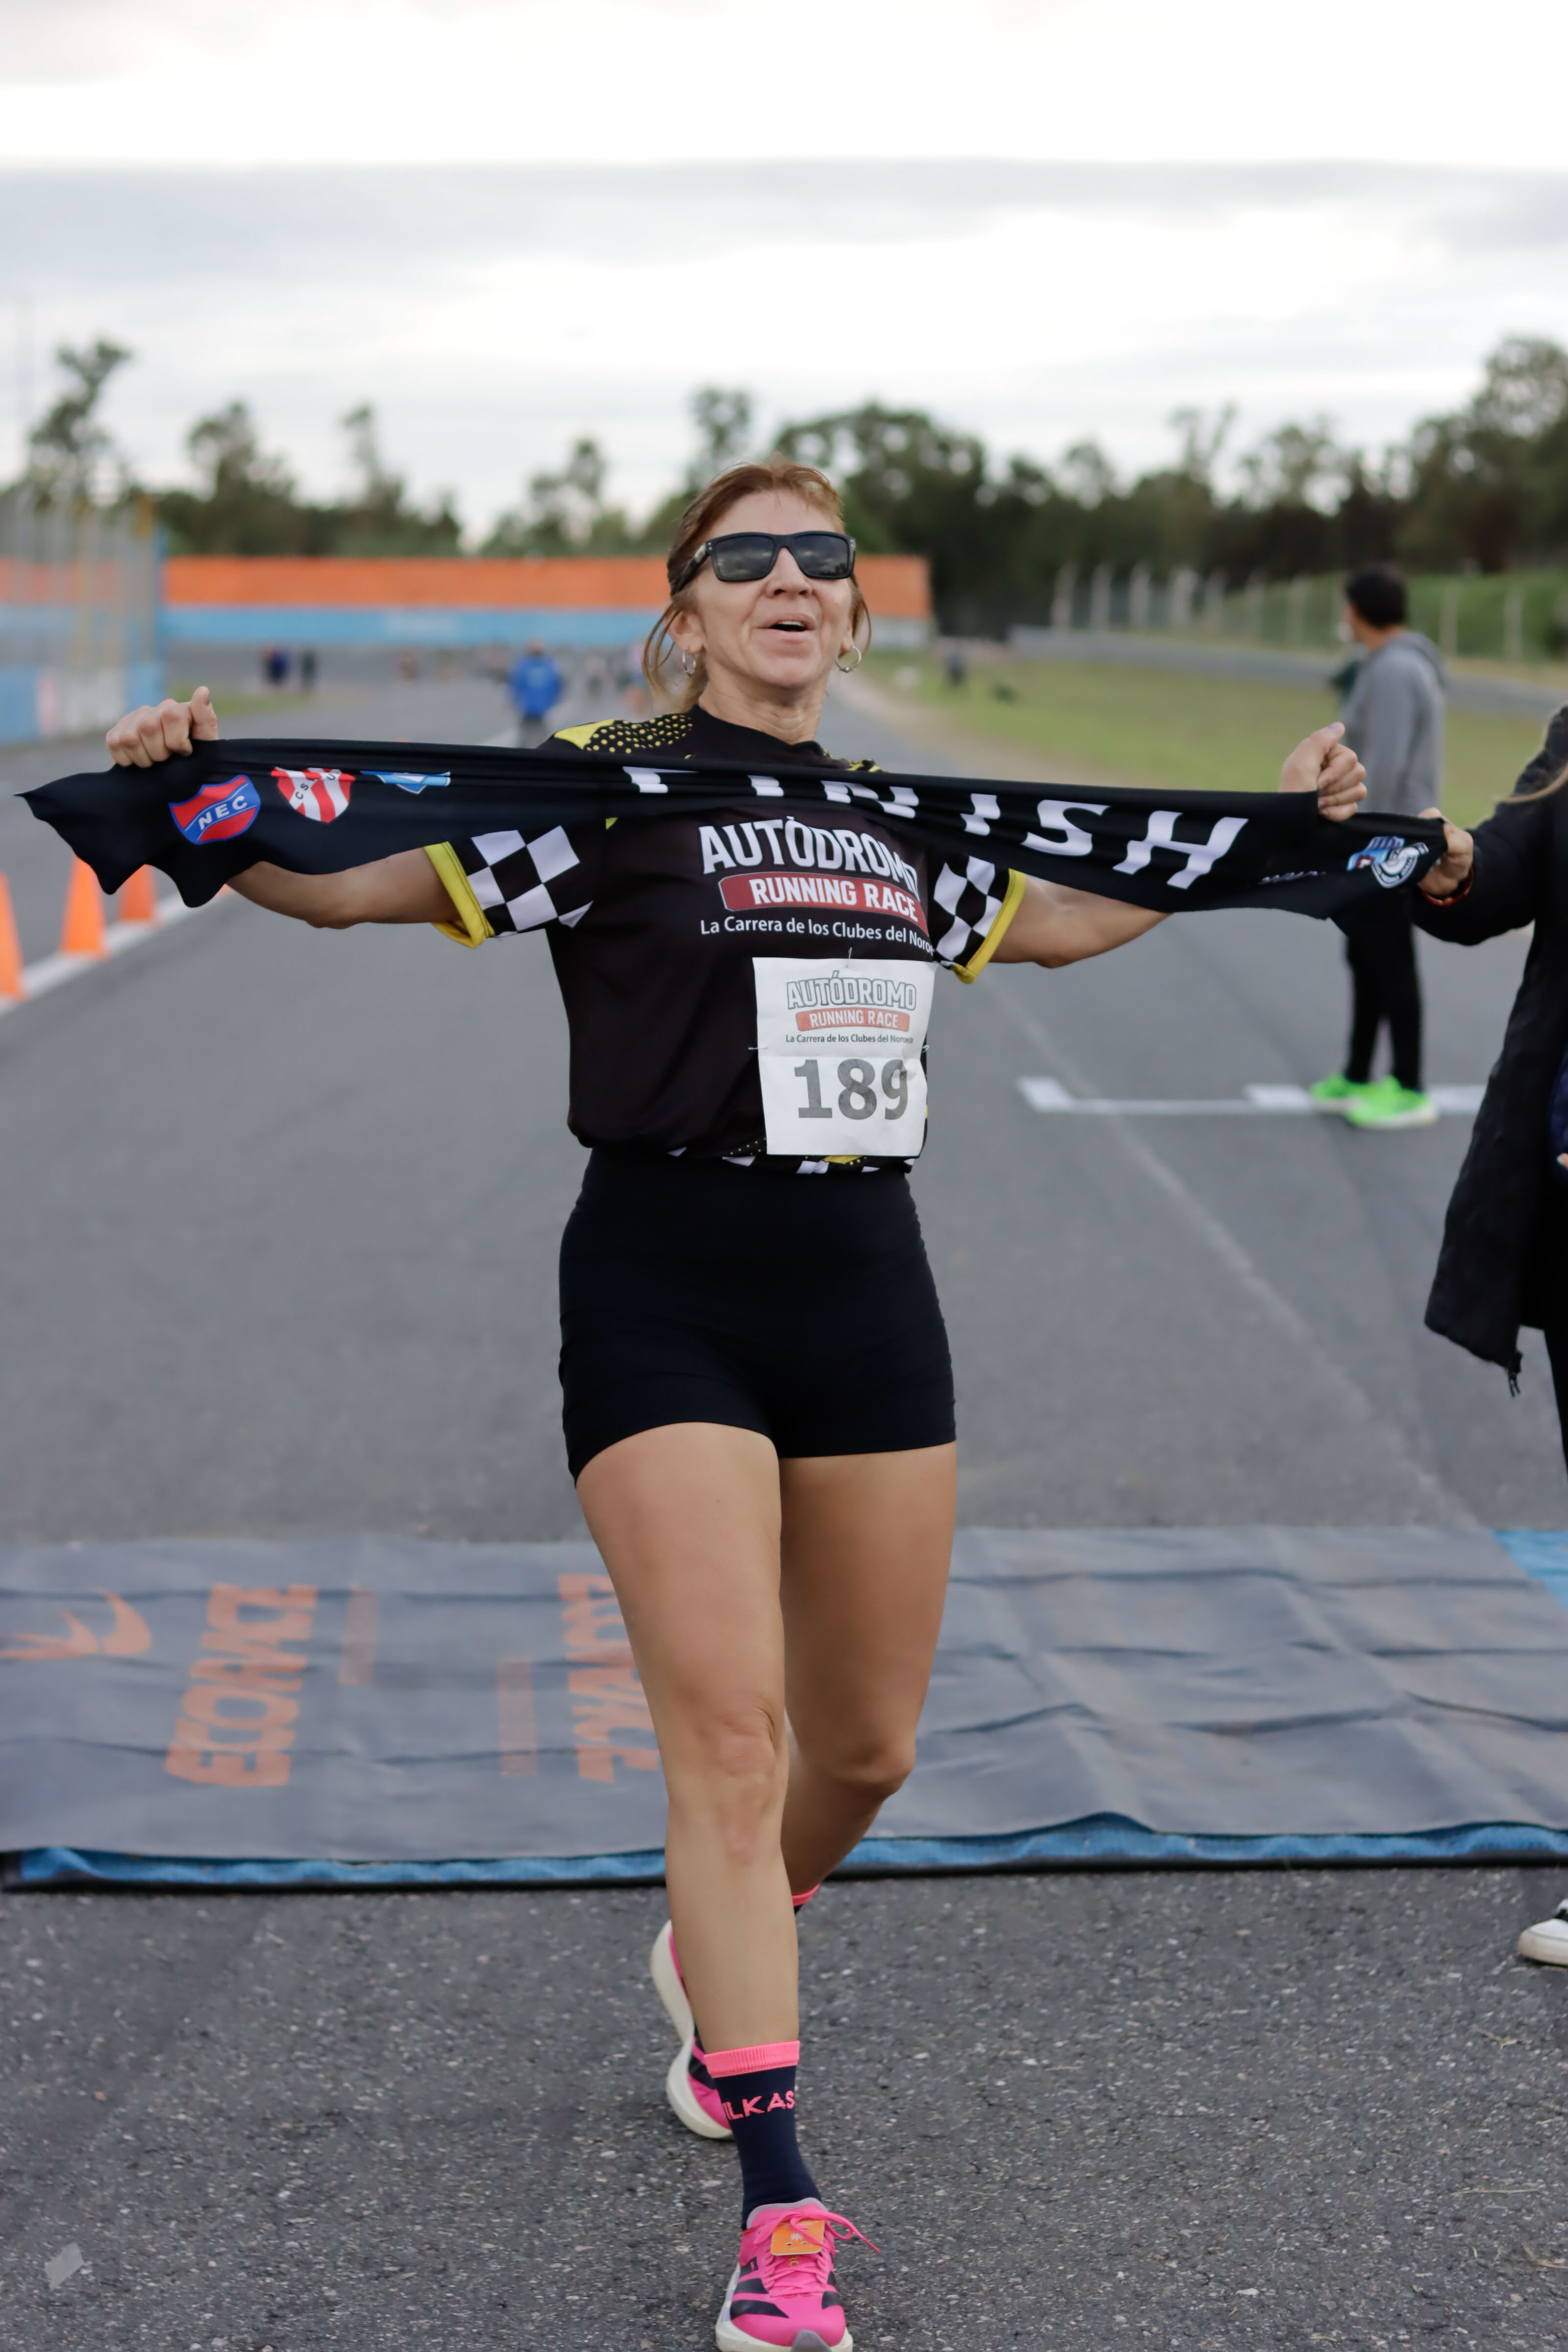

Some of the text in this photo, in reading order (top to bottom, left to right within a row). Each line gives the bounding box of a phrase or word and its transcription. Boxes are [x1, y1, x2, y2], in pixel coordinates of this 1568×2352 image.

[198, 795, 247, 831] NEC
[749, 877, 919, 922] RUNNING RACE
[701, 920, 719, 934] La
[724, 916, 782, 931] Carrera
[786, 917, 805, 933] de
[808, 919, 829, 935] los
[833, 922, 882, 939] Clubes
[885, 925, 906, 942] del
[786, 970, 917, 1011] AUTÓDROMO
[809, 1010, 899, 1028] RUNNING RACE
[785, 1034, 794, 1042] La
[796, 1034, 825, 1042] Carrera
[827, 1034, 836, 1042] de
[838, 1034, 849, 1042] los
[851, 1034, 876, 1042] Clubes
[877, 1034, 888, 1042] del
[794, 1058, 908, 1121] 189
[722, 2090, 796, 2120] LKAS
